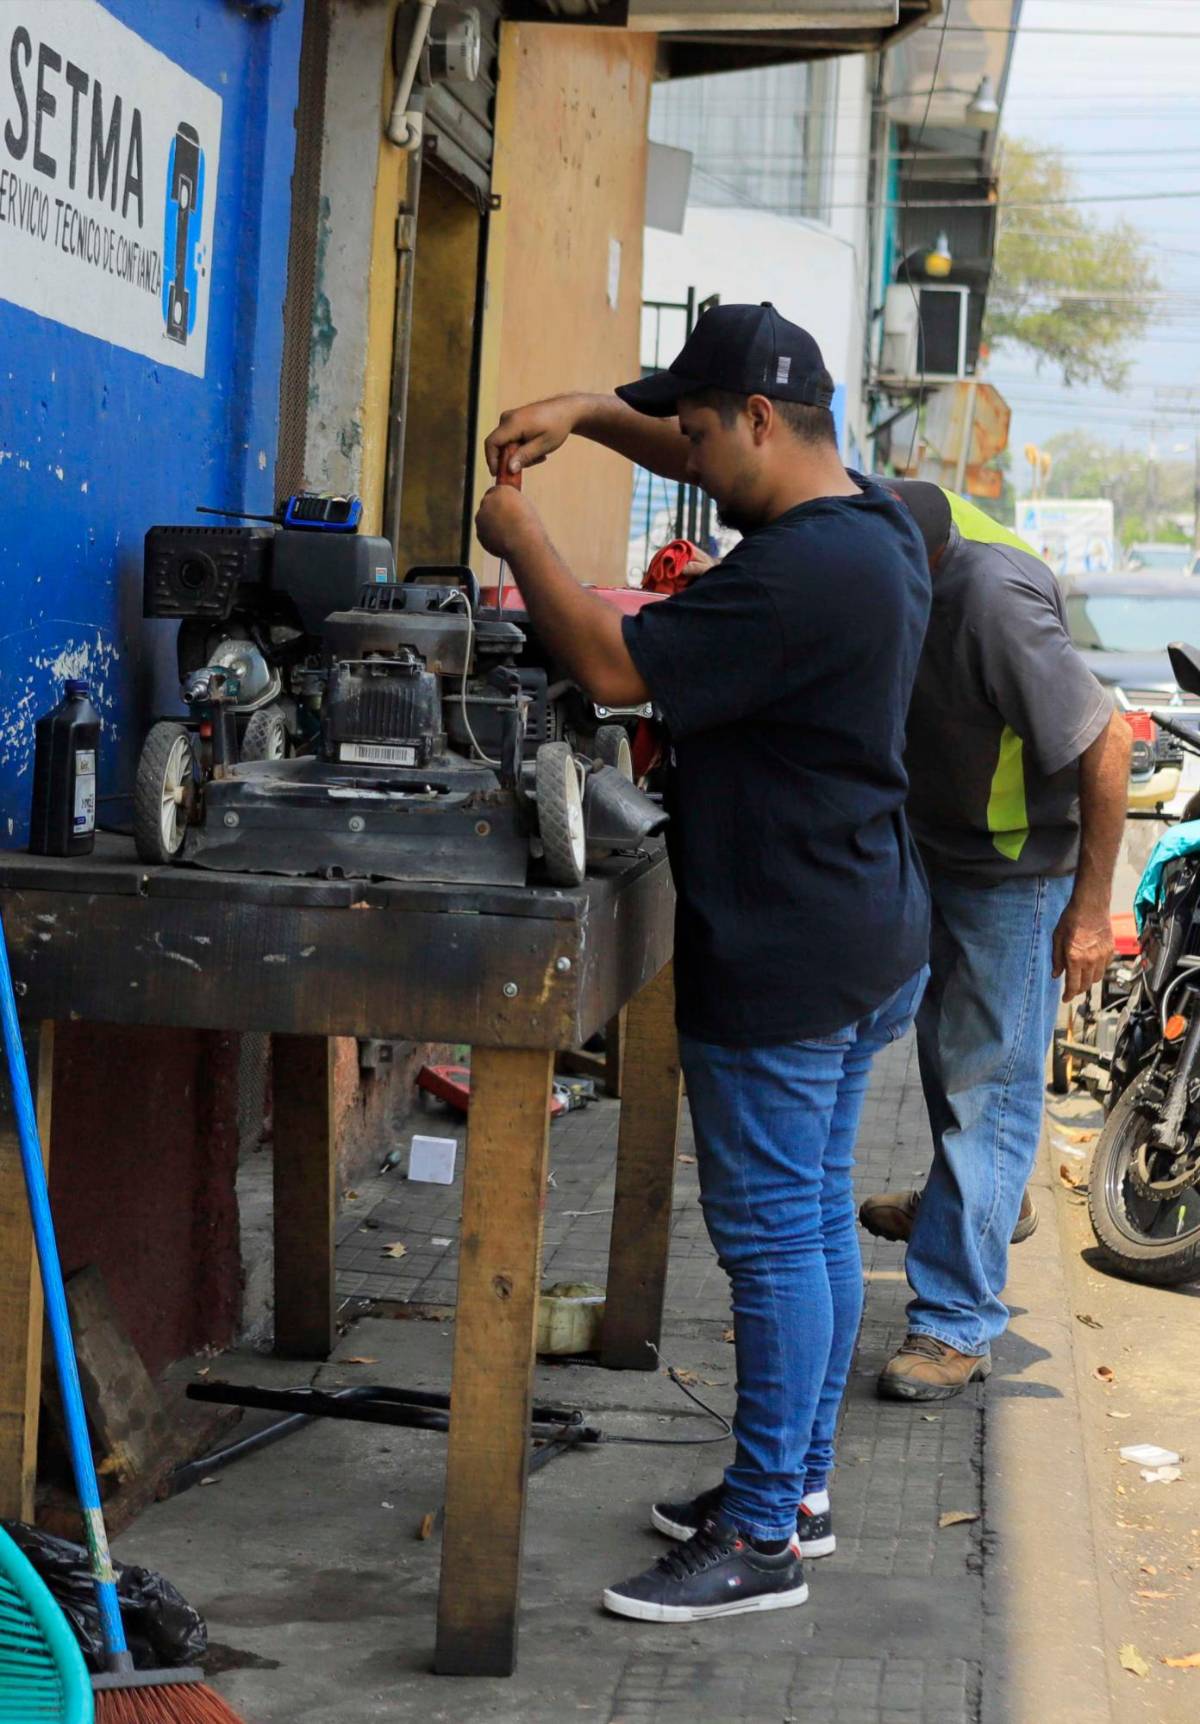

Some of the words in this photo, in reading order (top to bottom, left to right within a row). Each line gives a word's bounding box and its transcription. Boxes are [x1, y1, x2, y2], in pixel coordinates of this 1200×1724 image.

[4, 26, 144, 229] SETMA
[55, 198, 100, 266] TECNICO
[103, 226, 115, 274] DE
[116, 235, 162, 297] CONFIANZA
